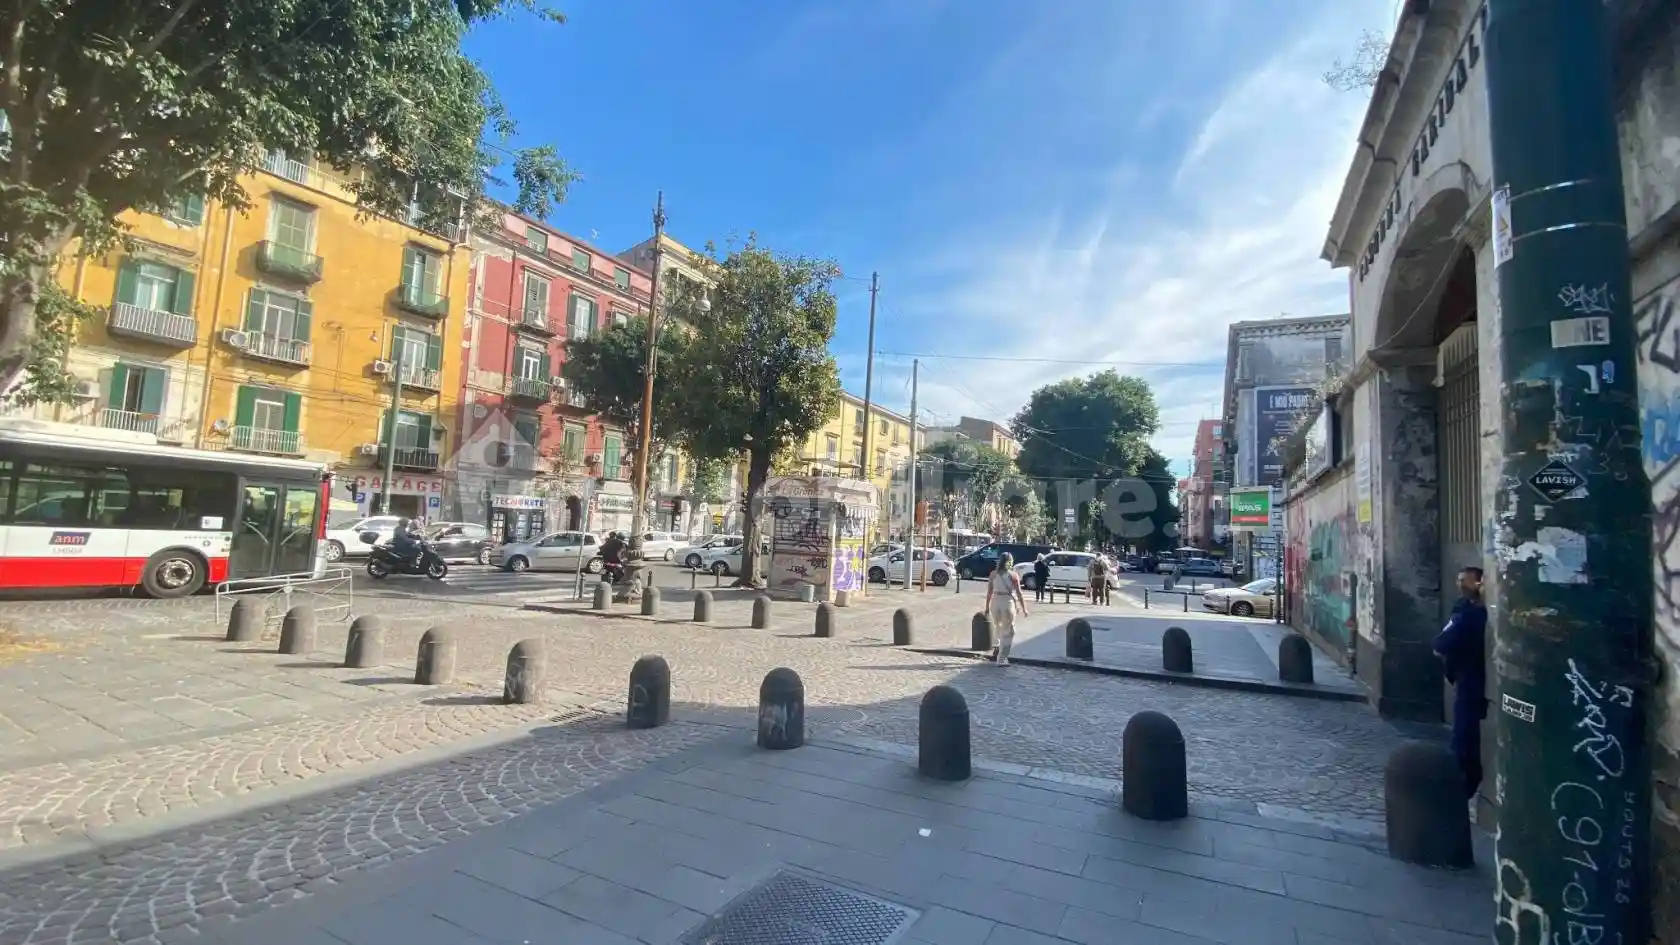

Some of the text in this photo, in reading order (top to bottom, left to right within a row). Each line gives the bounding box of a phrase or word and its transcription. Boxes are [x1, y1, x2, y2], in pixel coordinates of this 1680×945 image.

[354, 475, 442, 493] GARAGE
[1535, 475, 1577, 485] LAVISH
[55, 535, 85, 544] anm
